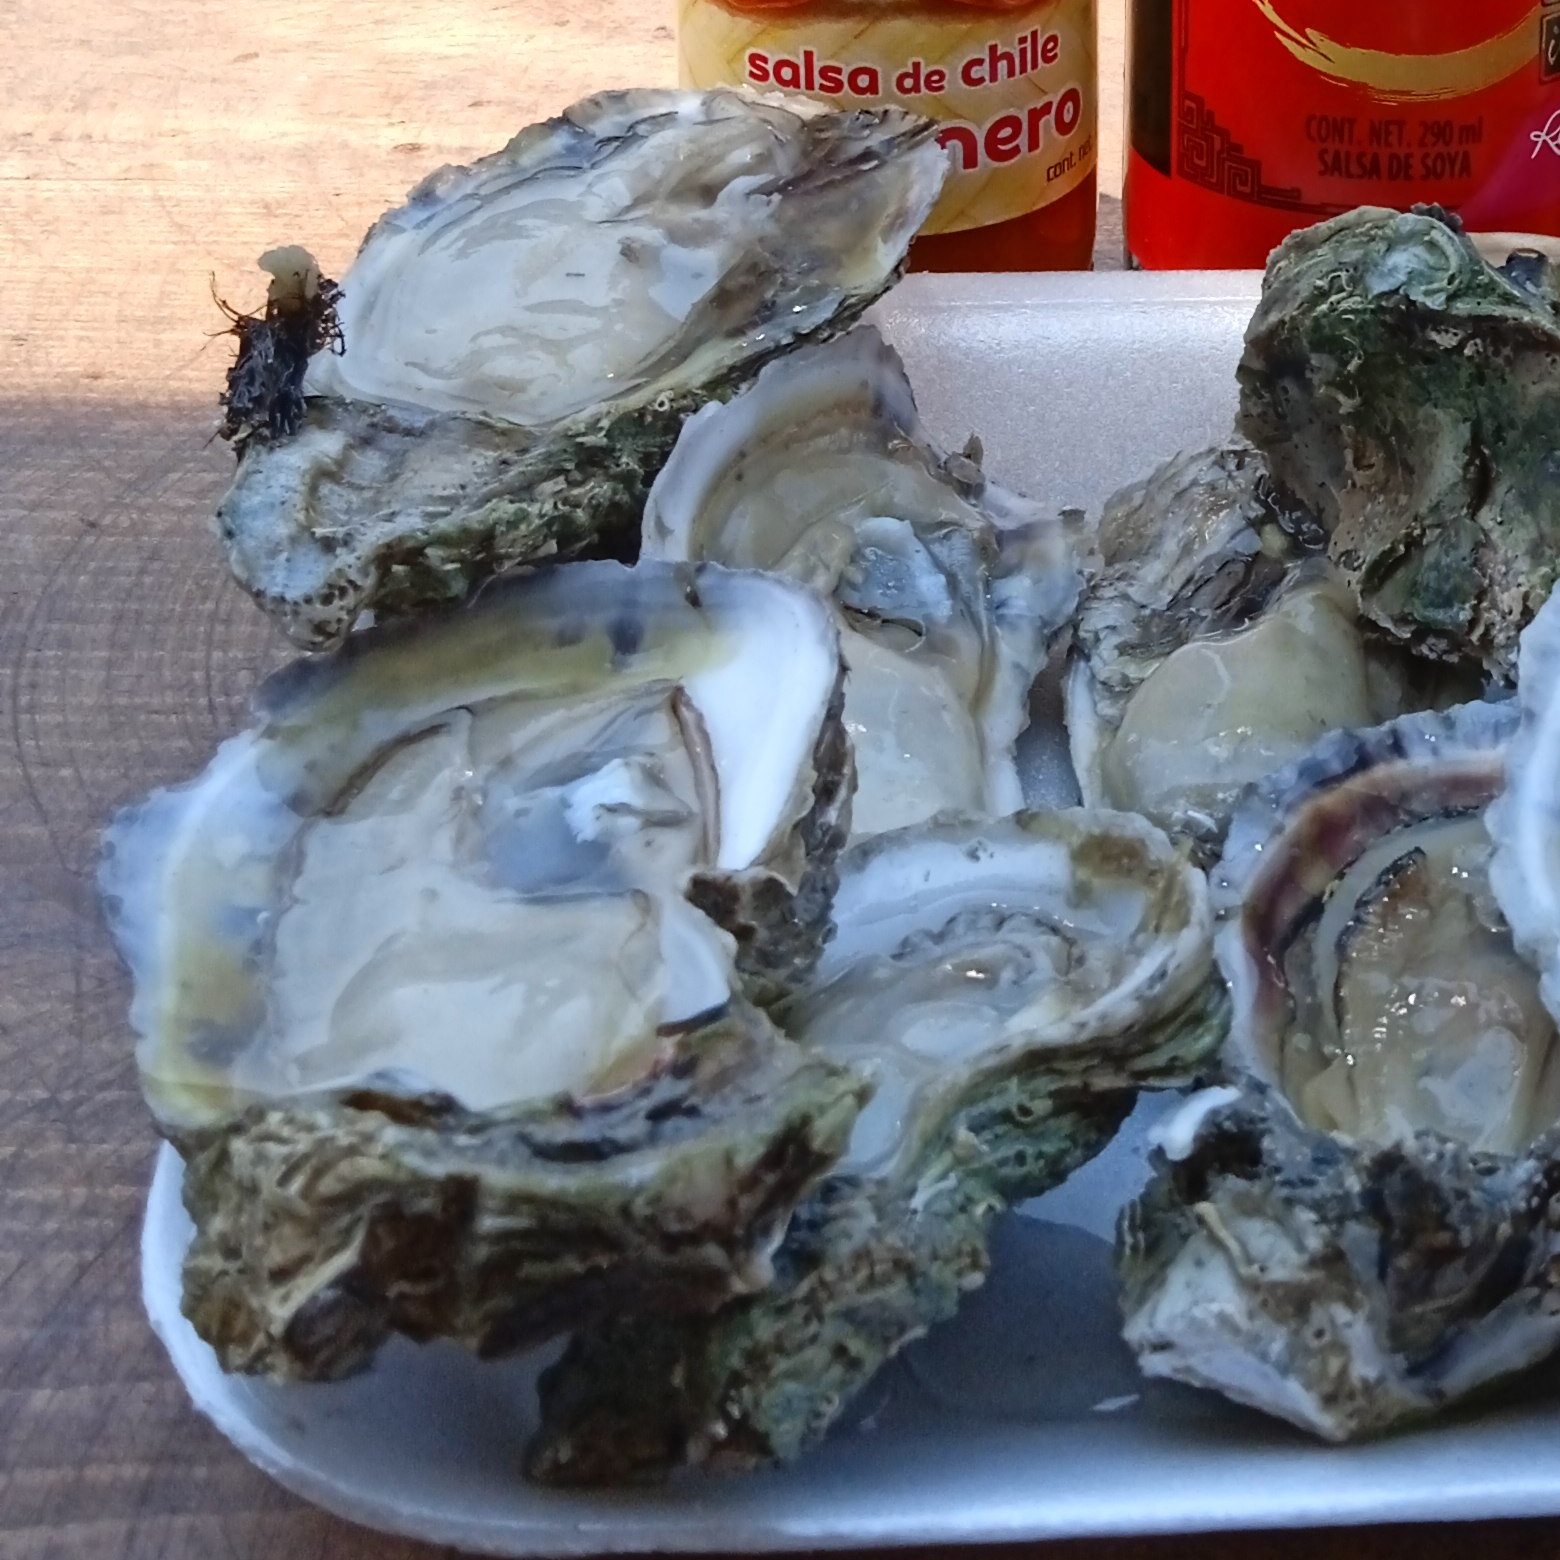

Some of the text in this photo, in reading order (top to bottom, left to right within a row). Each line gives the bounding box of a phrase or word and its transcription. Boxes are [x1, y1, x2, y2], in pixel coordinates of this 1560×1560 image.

[747, 28, 1060, 96] salsa de chile
[935, 87, 1081, 170] nero
[1305, 114, 1484, 148] CONT. NET. 290 ml
[1318, 148, 1472, 181] SALSA DE SOYA
